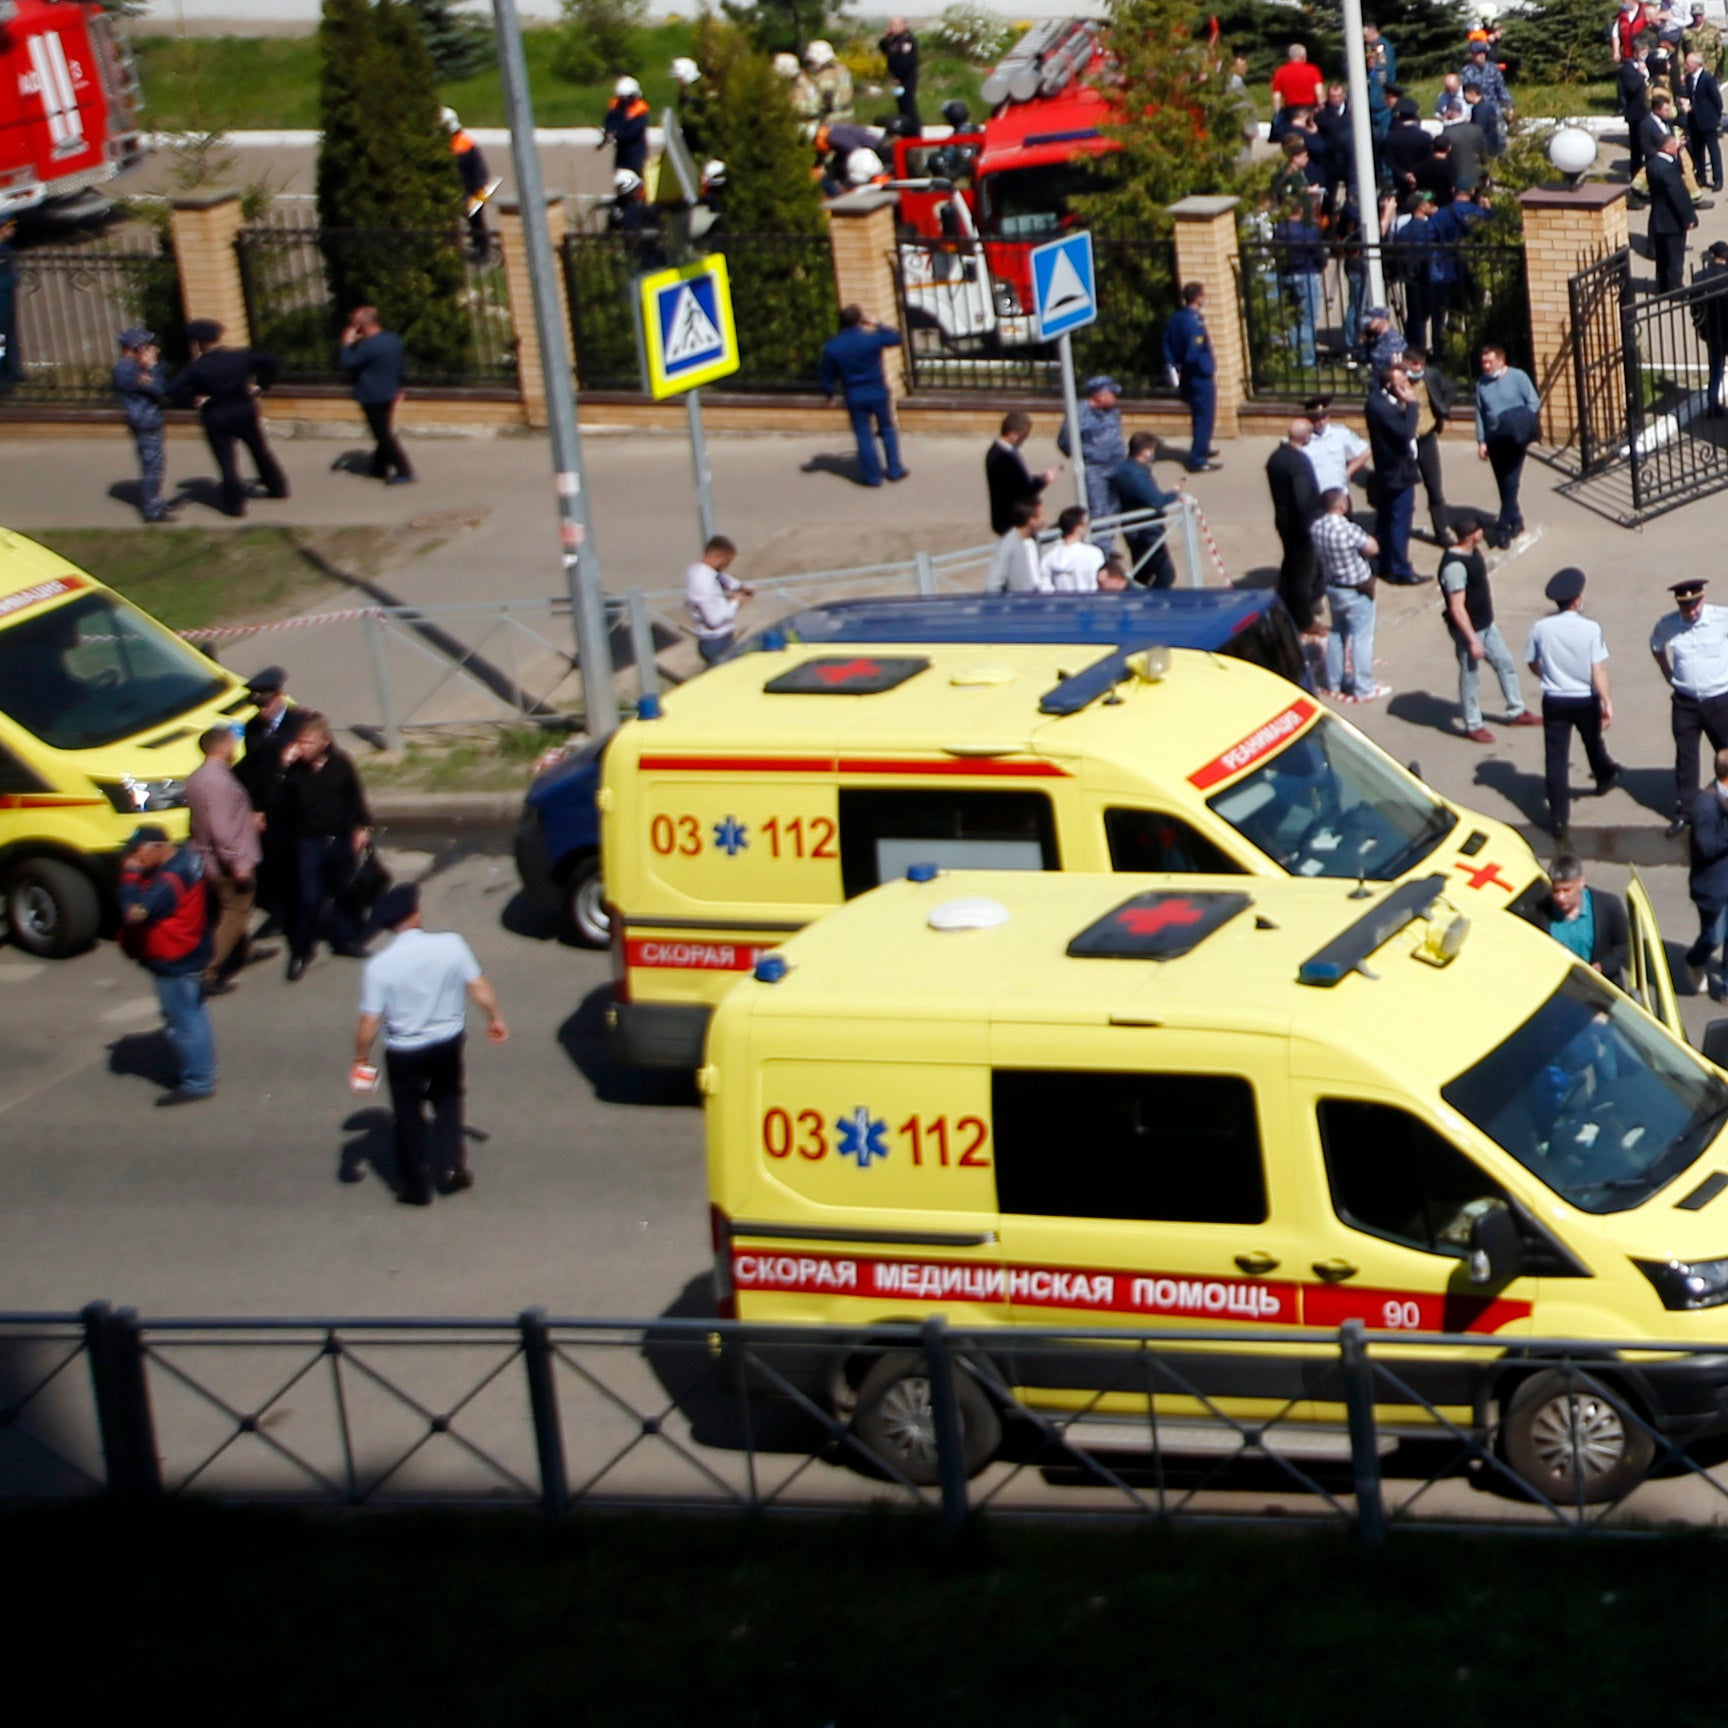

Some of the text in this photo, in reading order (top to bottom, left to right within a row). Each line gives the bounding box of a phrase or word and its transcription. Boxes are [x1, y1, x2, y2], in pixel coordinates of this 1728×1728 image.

[1220, 709, 1304, 771] РЕАНИМАЦИЯ
[651, 813, 838, 858] 03 112
[640, 942, 735, 967] СКОРАЯ
[763, 1106, 992, 1167] 03 112
[735, 1255, 1281, 1318] СКОРАЯ МЕДИЦИНСКАЯ ПОМОЩЬ
[1383, 1300, 1420, 1329] 90
